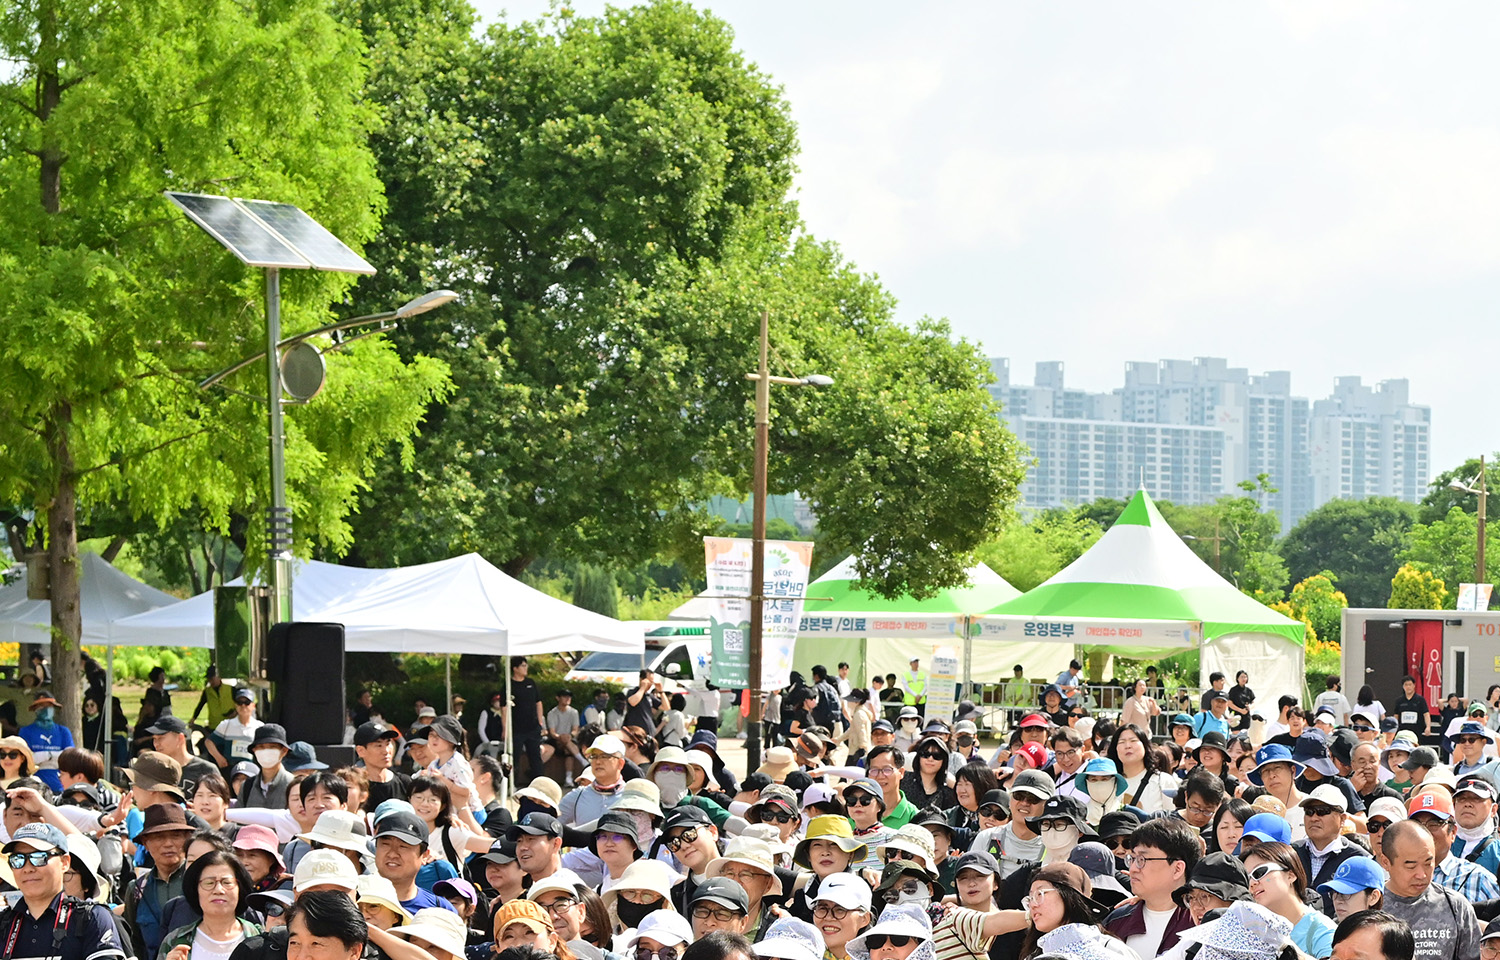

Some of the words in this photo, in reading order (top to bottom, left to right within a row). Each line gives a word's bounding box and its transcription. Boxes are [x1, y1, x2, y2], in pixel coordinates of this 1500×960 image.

[1024, 622, 1074, 638] 운영본부
[1086, 627, 1116, 637] (개인접수
[1118, 628, 1142, 638] 확인처)
